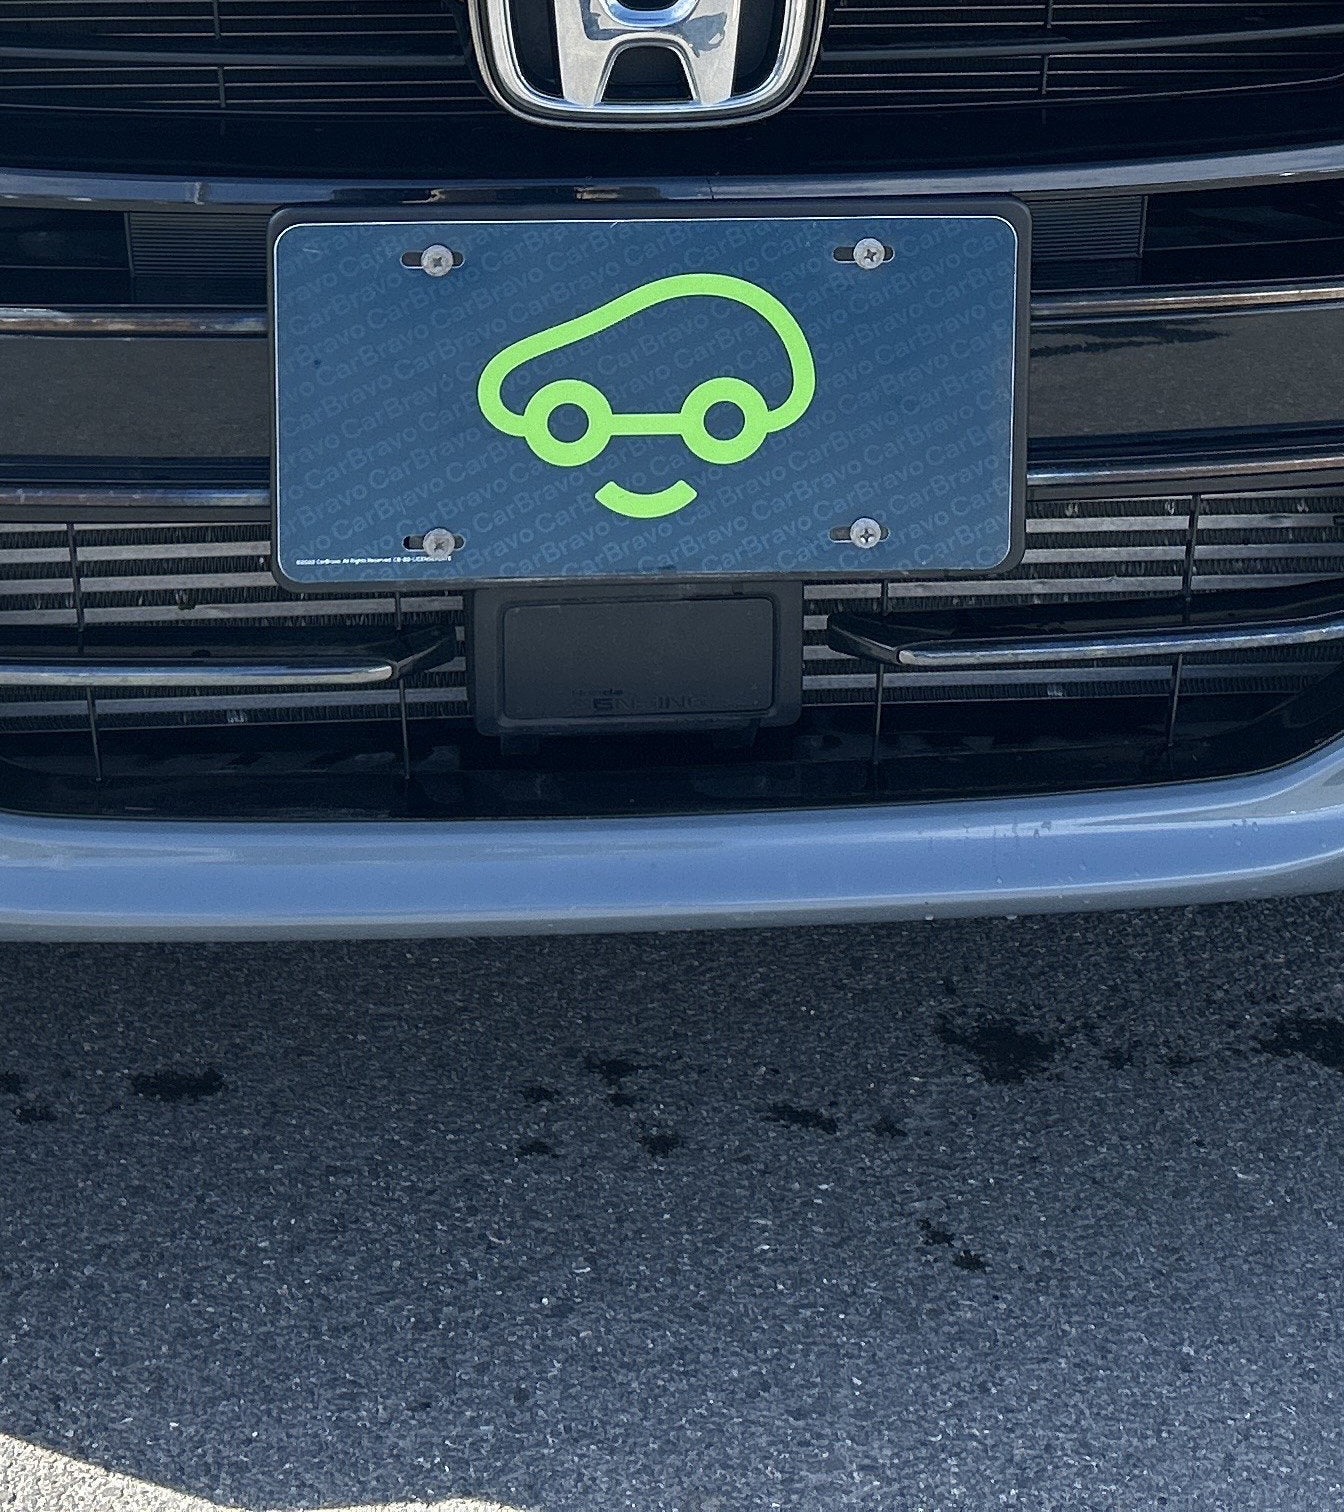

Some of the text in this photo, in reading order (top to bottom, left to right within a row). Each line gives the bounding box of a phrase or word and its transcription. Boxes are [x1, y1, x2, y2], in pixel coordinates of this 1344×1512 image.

[289, 273, 402, 335] CarBravo
[367, 267, 480, 328] CarBravo
[850, 254, 960, 313] CarBravo
[282, 375, 392, 437] CarBravo
[394, 318, 506, 380] CarBravo
[508, 262, 620, 323] CarBravo
[316, 324, 429, 386] CarBravo
[431, 268, 543, 328] CarBravo
[874, 305, 985, 364] CarBravo
[342, 377, 453, 438] CarBravo
[369, 427, 480, 489] CarBravo
[598, 314, 708, 375] CarBravo
[788, 410, 898, 470] CarBravo
[901, 356, 1011, 415] CarBravo
[838, 354, 948, 414] CarBravo
[305, 427, 417, 489] CarBravo
[752, 460, 862, 520] CarBravo
[864, 405, 974, 465] CarBravo
[889, 455, 998, 514] CarBravo
[473, 473, 584, 533] CarBravo
[814, 460, 924, 520] CarBravo
